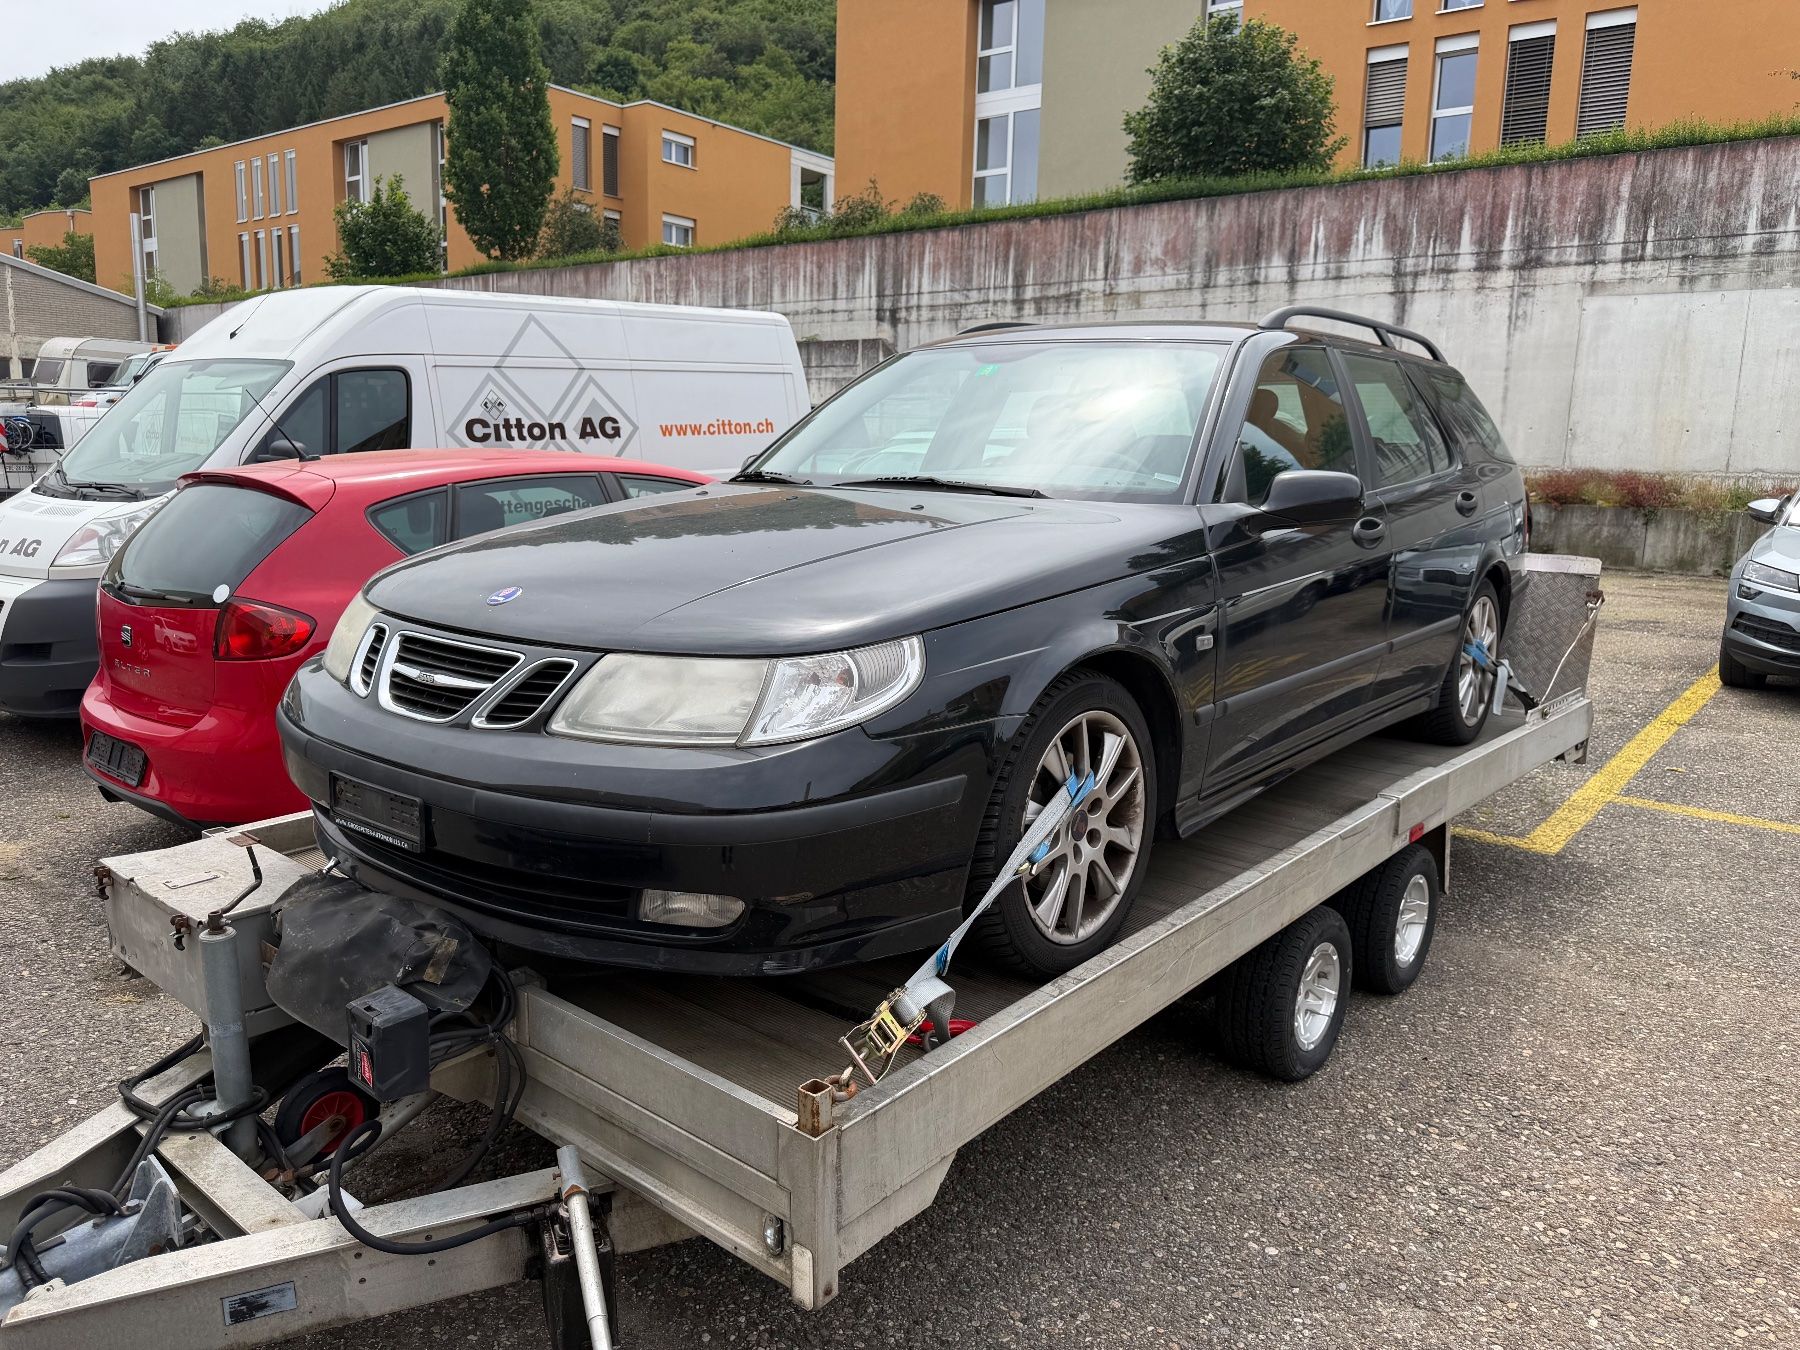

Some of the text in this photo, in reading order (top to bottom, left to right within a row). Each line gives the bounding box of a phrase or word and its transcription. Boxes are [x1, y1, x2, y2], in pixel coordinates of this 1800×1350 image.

[465, 416, 621, 443] Citton AG
[659, 418, 774, 437] www.citton.ch
[9, 537, 42, 558] AG
